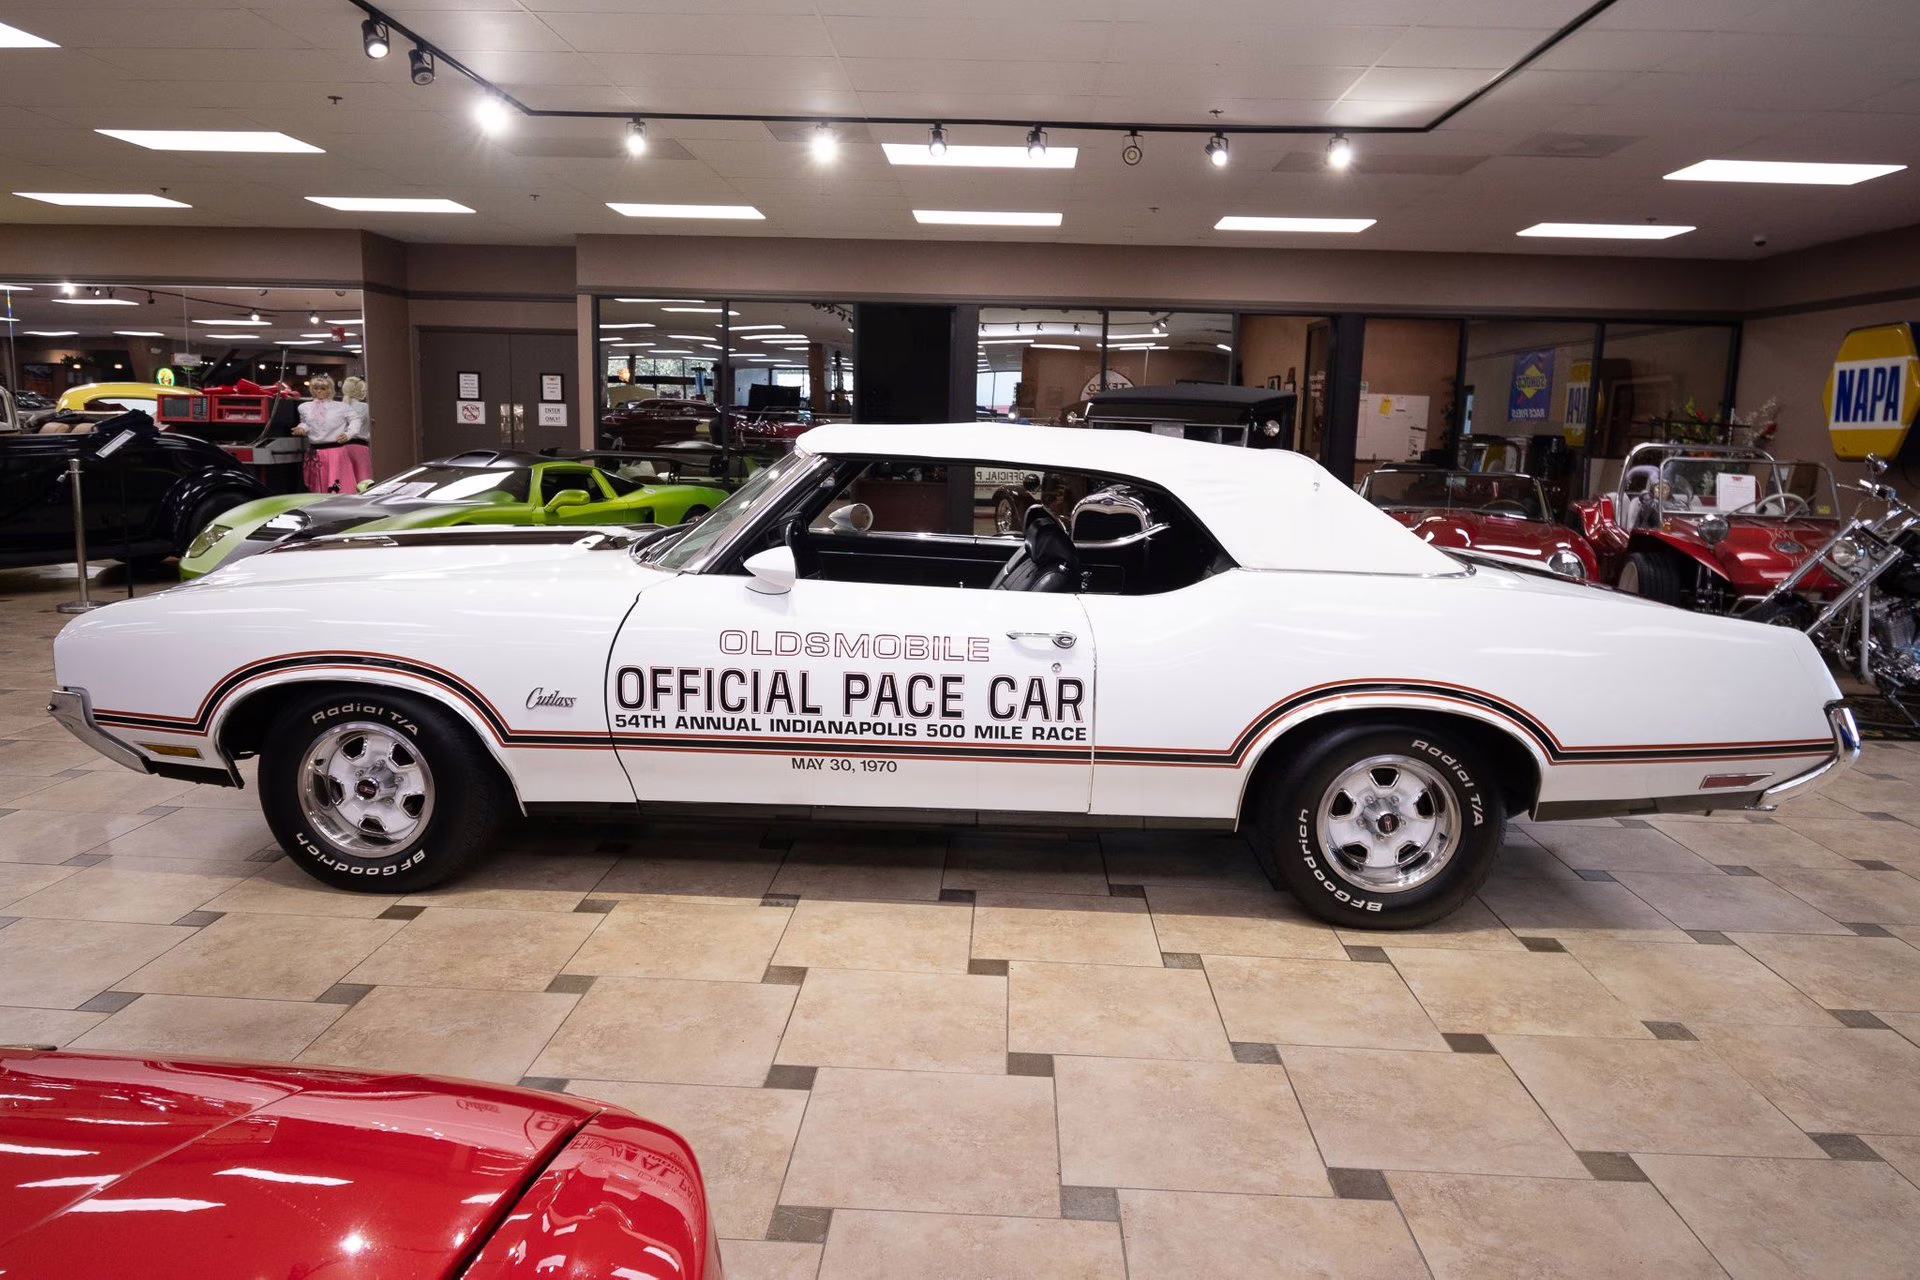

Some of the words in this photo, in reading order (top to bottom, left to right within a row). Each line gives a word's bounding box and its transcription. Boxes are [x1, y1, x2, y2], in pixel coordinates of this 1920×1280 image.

[1834, 365, 1901, 423] NAPA
[718, 629, 990, 663] OLDSMOBILE
[525, 687, 577, 710] Cutlass
[614, 664, 823, 717] OFFICIAL
[842, 671, 965, 721] PACE
[987, 674, 1085, 723] CAR
[311, 703, 383, 724] Radial
[390, 711, 419, 737] T/A
[615, 714, 666, 729] 54TH
[674, 716, 762, 732] ANNUAL
[769, 718, 917, 737] INDIANAPOLIS
[926, 723, 966, 739] 500
[974, 725, 1023, 740] MILE
[1032, 726, 1087, 741] RACE
[791, 757, 825, 771] MAY
[829, 758, 856, 774] 30,
[859, 759, 898, 773] 1970
[1411, 739, 1474, 788] Radial
[1470, 793, 1484, 827] T/A
[296, 832, 426, 876] BFGoodrich
[1298, 809, 1383, 912] BFGoodrich
